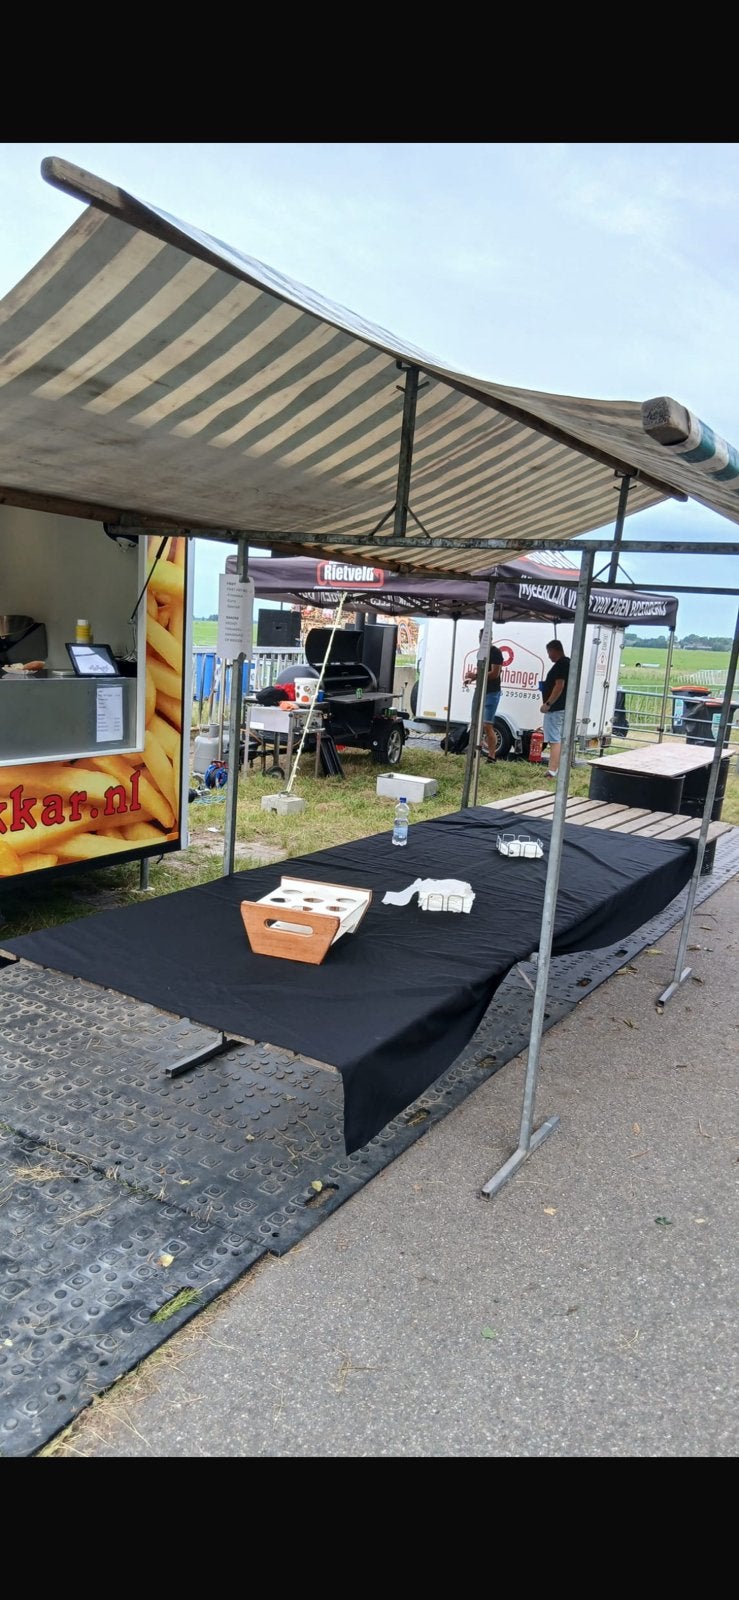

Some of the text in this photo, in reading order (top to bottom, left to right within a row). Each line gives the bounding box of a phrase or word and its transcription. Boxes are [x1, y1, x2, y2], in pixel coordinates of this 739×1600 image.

[592, 595, 611, 614] VAN
[608, 597, 631, 617] EIGEN
[505, 690, 541, 701] 29508785
[0, 770, 141, 834] kar.nl
